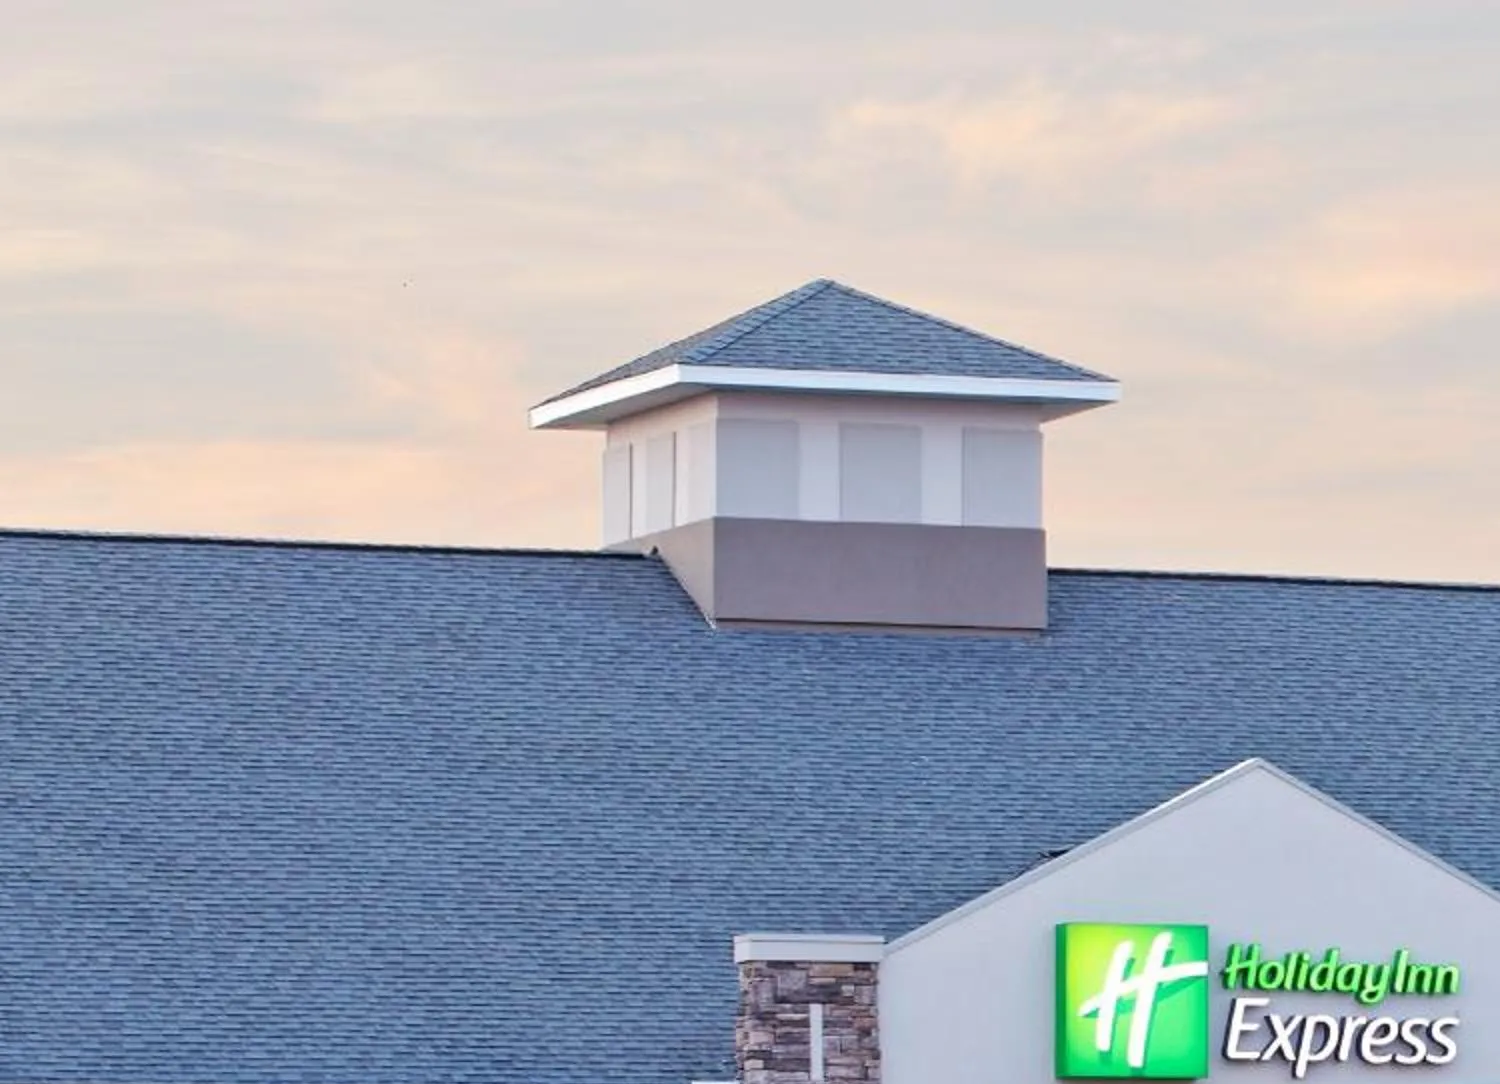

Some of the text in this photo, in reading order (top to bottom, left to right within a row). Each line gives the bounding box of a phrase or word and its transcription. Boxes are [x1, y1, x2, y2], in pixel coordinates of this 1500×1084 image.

[1077, 931, 1208, 1069] H
[1223, 943, 1460, 1004] Holiday Inn
[1222, 997, 1460, 1079] Express
